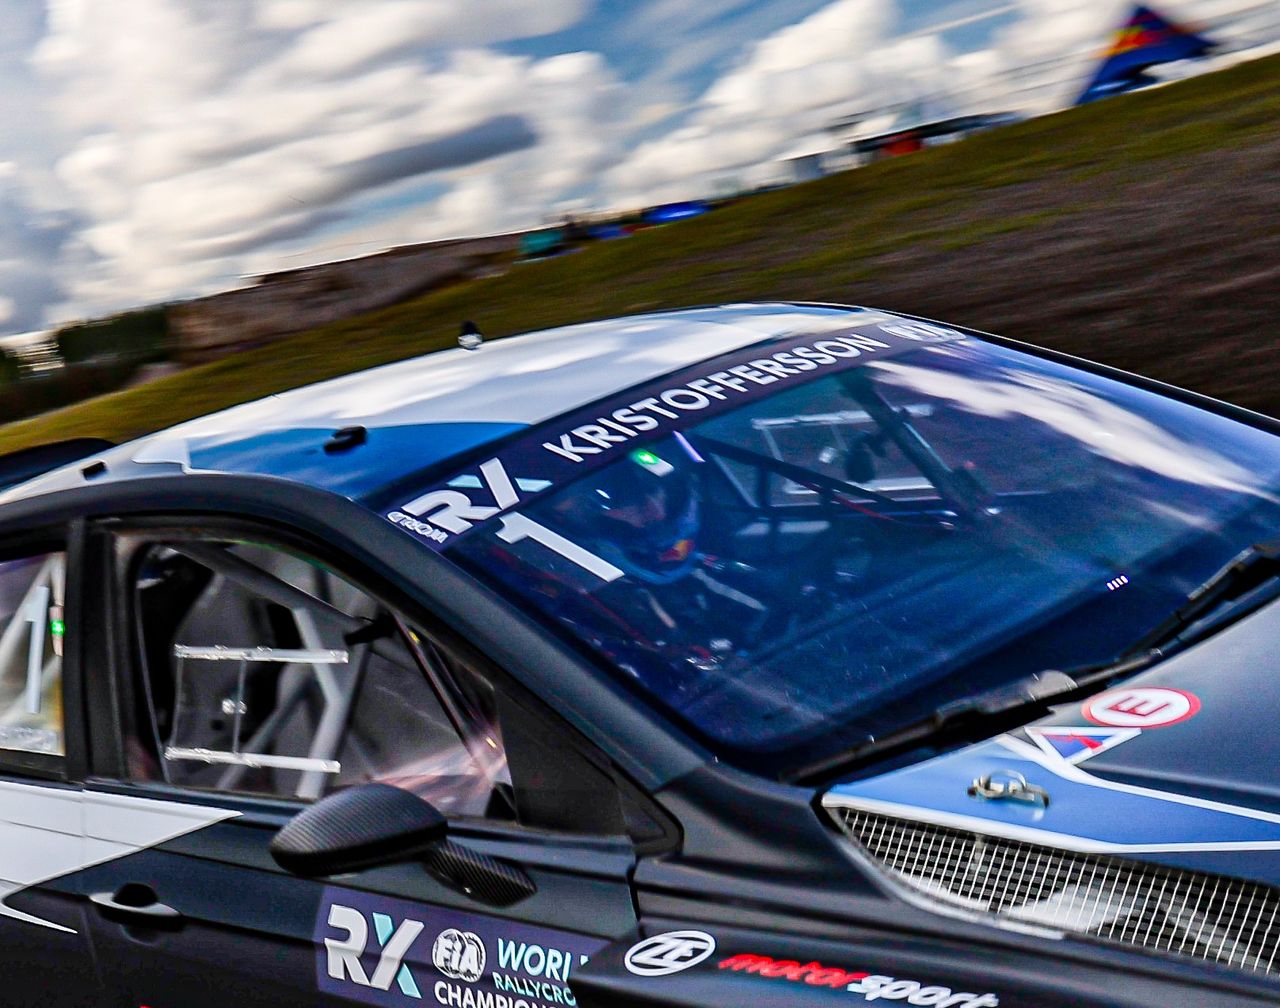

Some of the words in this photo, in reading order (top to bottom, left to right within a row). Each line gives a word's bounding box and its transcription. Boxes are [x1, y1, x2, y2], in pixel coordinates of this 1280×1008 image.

[542, 333, 890, 463] KRISTOFFERSSON
[401, 457, 553, 535] RX
[495, 511, 625, 582] 1
[324, 904, 424, 999] RX
[434, 932, 483, 978] FIA
